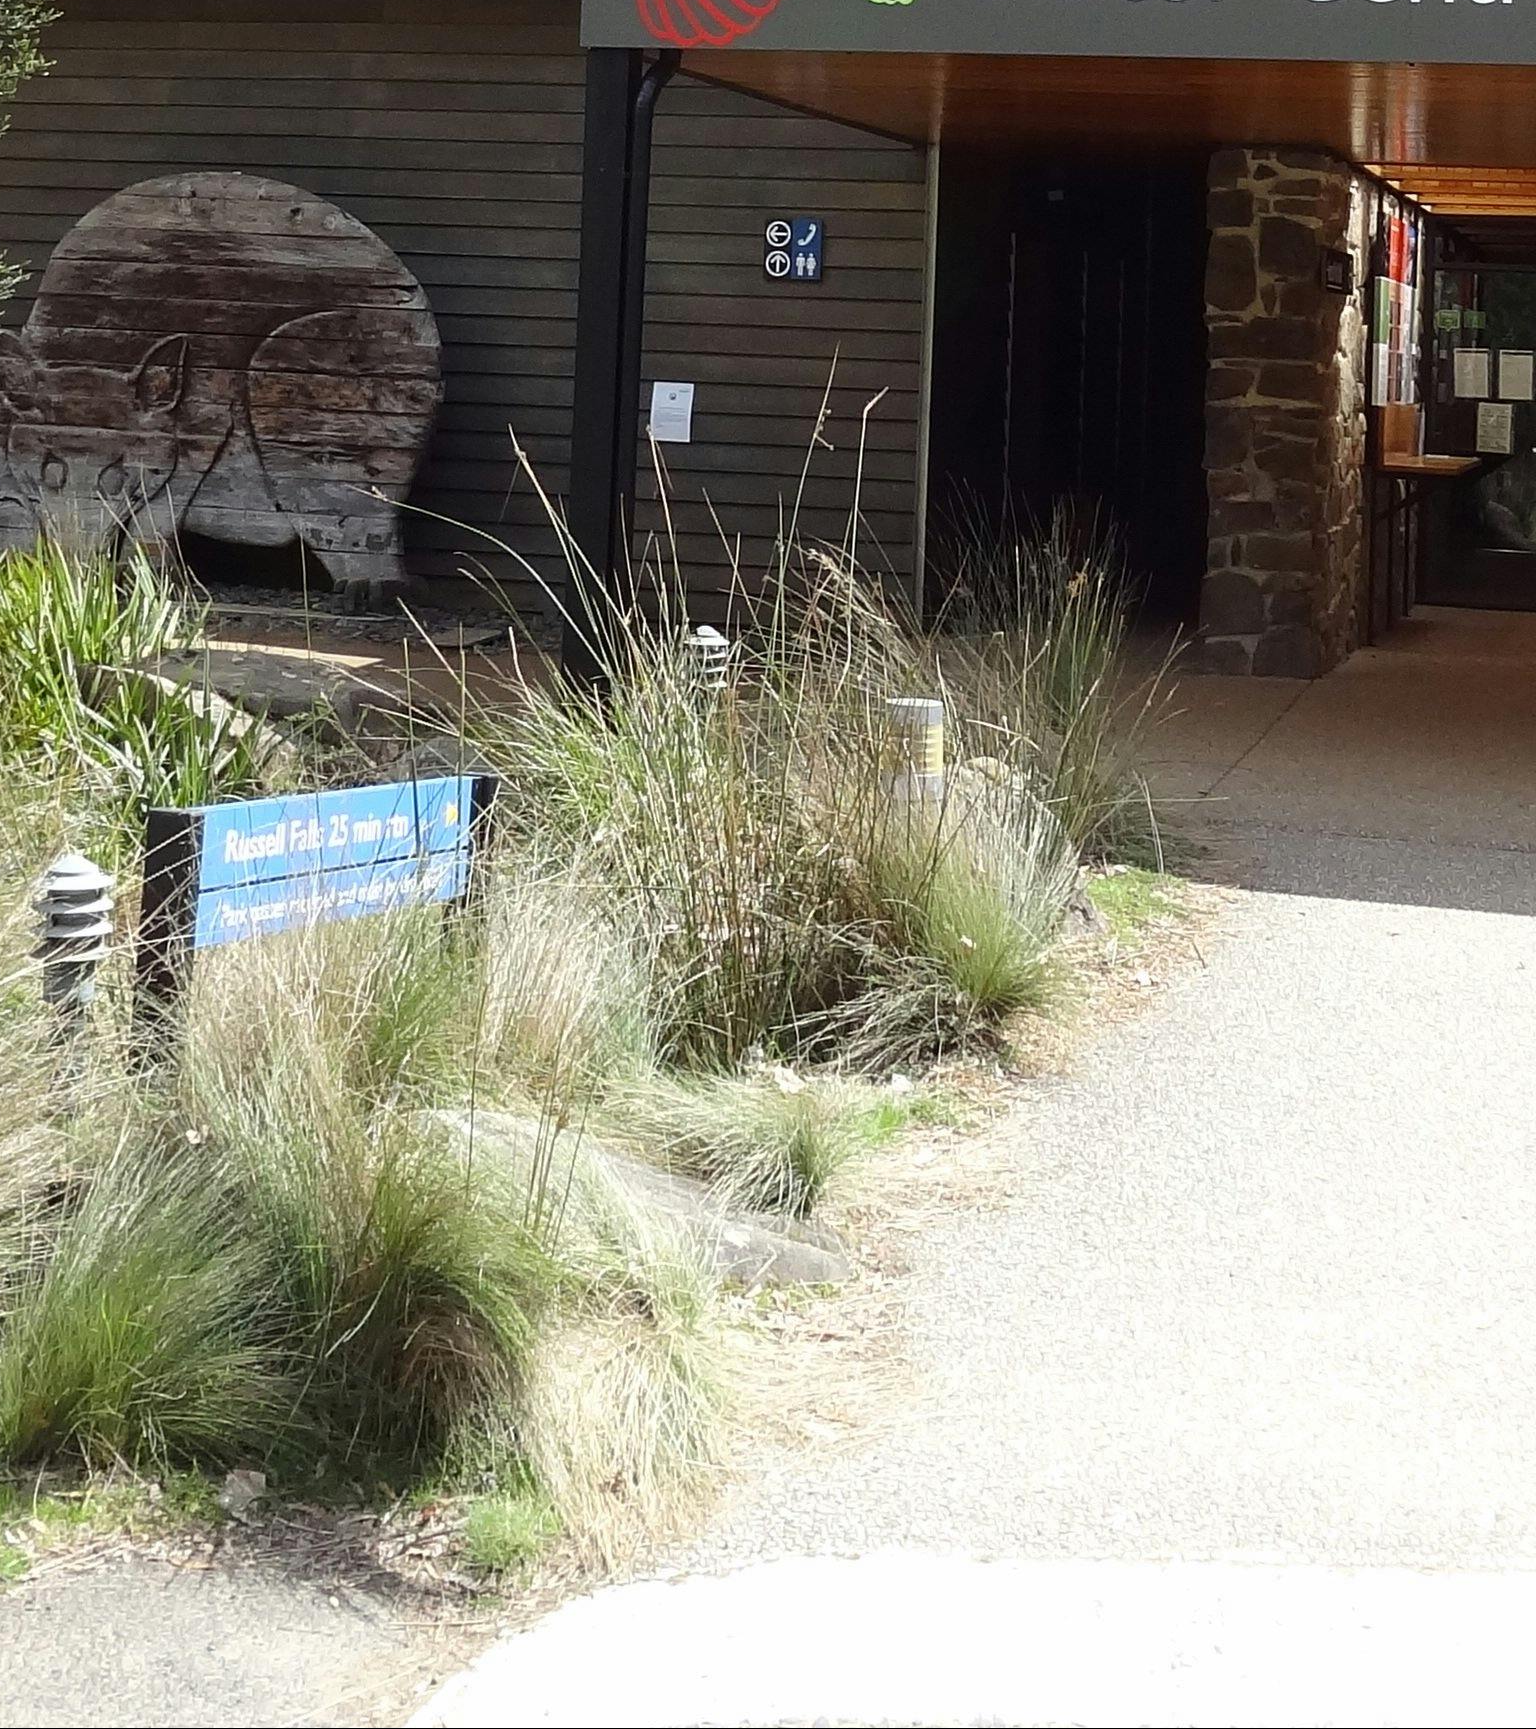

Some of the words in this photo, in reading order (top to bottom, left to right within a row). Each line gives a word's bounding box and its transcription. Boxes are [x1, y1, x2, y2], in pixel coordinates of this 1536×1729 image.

[224, 822, 286, 864] Russell
[290, 818, 324, 853] Falls
[328, 813, 349, 848] 25
[353, 813, 382, 844] min
